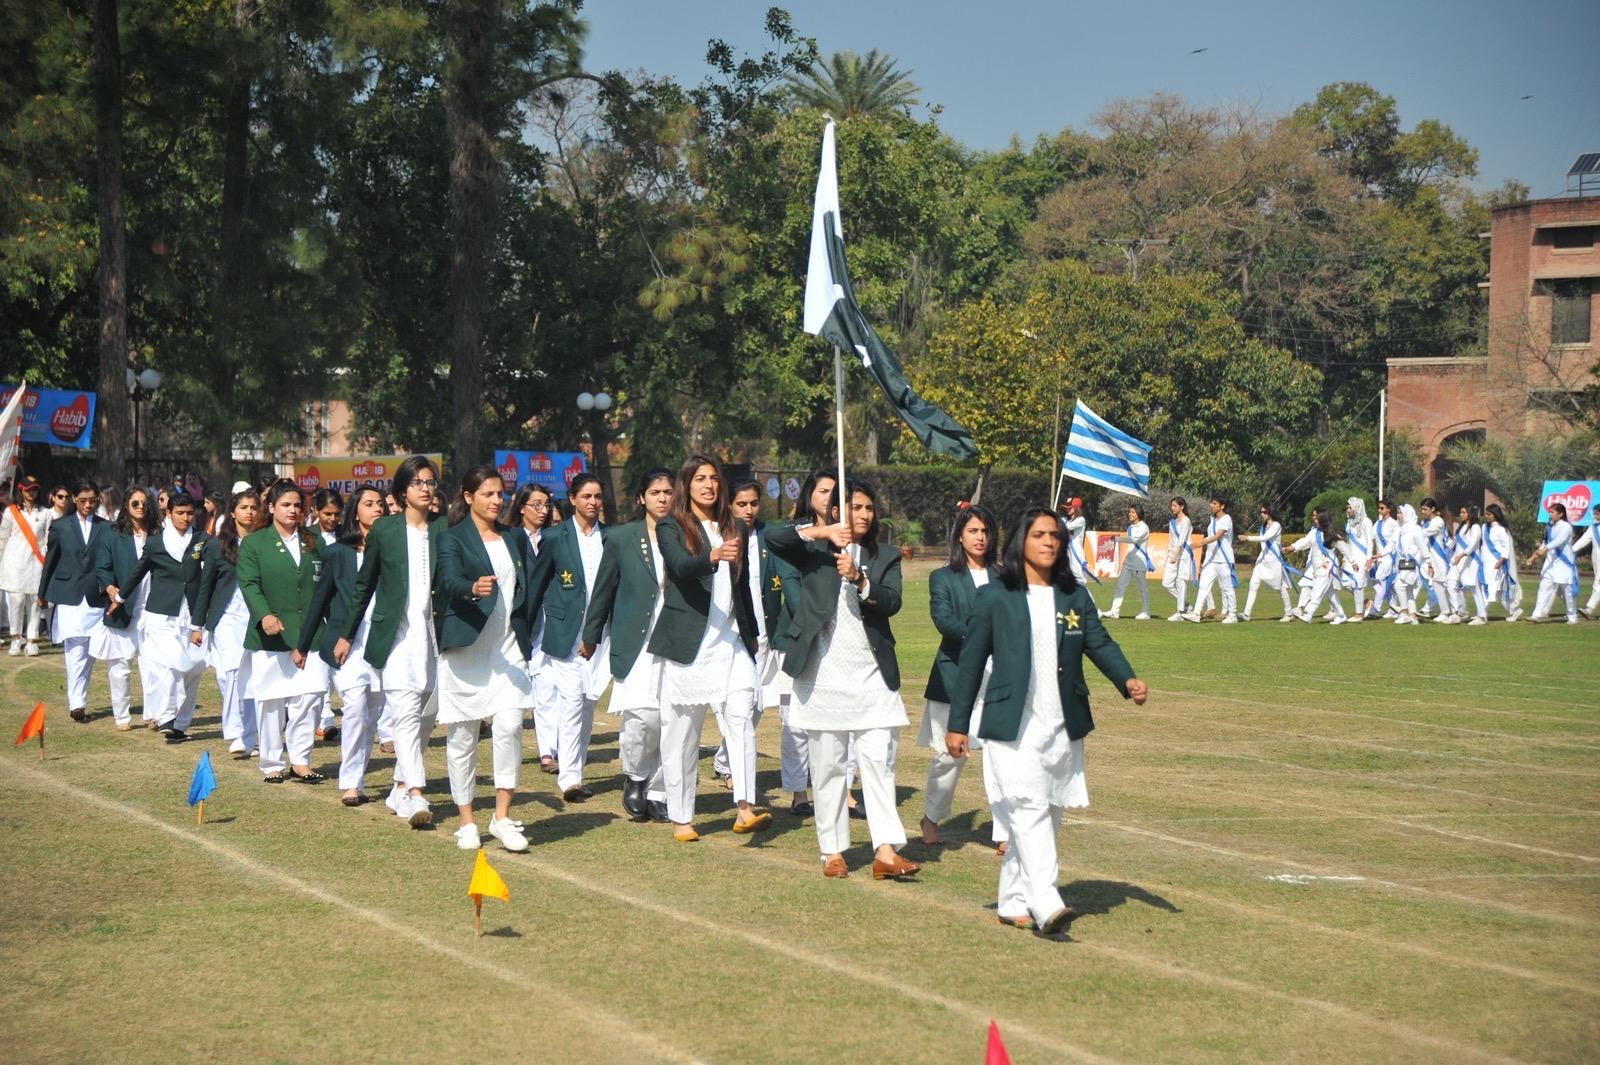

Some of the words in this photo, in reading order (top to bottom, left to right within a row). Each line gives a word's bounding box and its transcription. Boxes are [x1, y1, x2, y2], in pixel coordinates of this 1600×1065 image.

[1, 393, 37, 408] HIB
[53, 409, 88, 428] Habib
[530, 458, 552, 470] HAIB
[354, 465, 384, 477] HAIB
[297, 476, 320, 488] Habib
[1546, 495, 1589, 509] Habib
